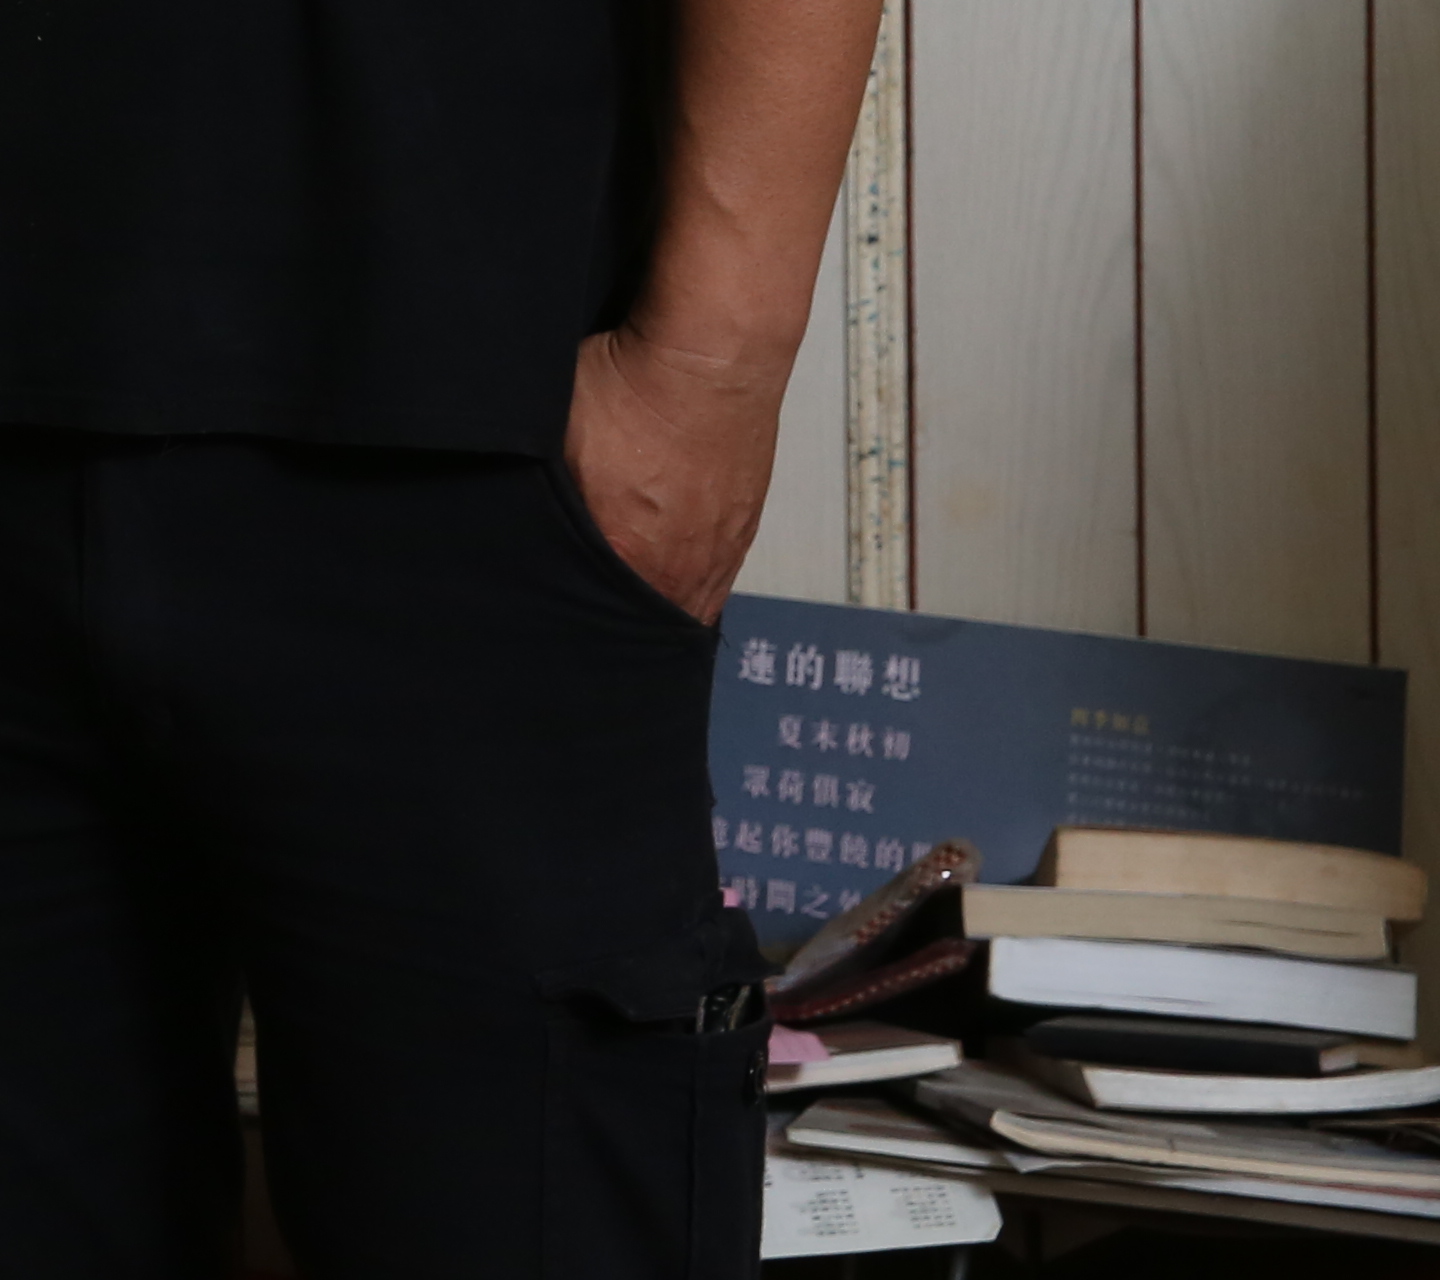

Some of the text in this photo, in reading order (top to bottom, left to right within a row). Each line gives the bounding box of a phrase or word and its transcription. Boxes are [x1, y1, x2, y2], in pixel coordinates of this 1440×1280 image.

[738, 637, 921, 702] 蓮的聯想
[779, 713, 911, 761] 夏末秋初
